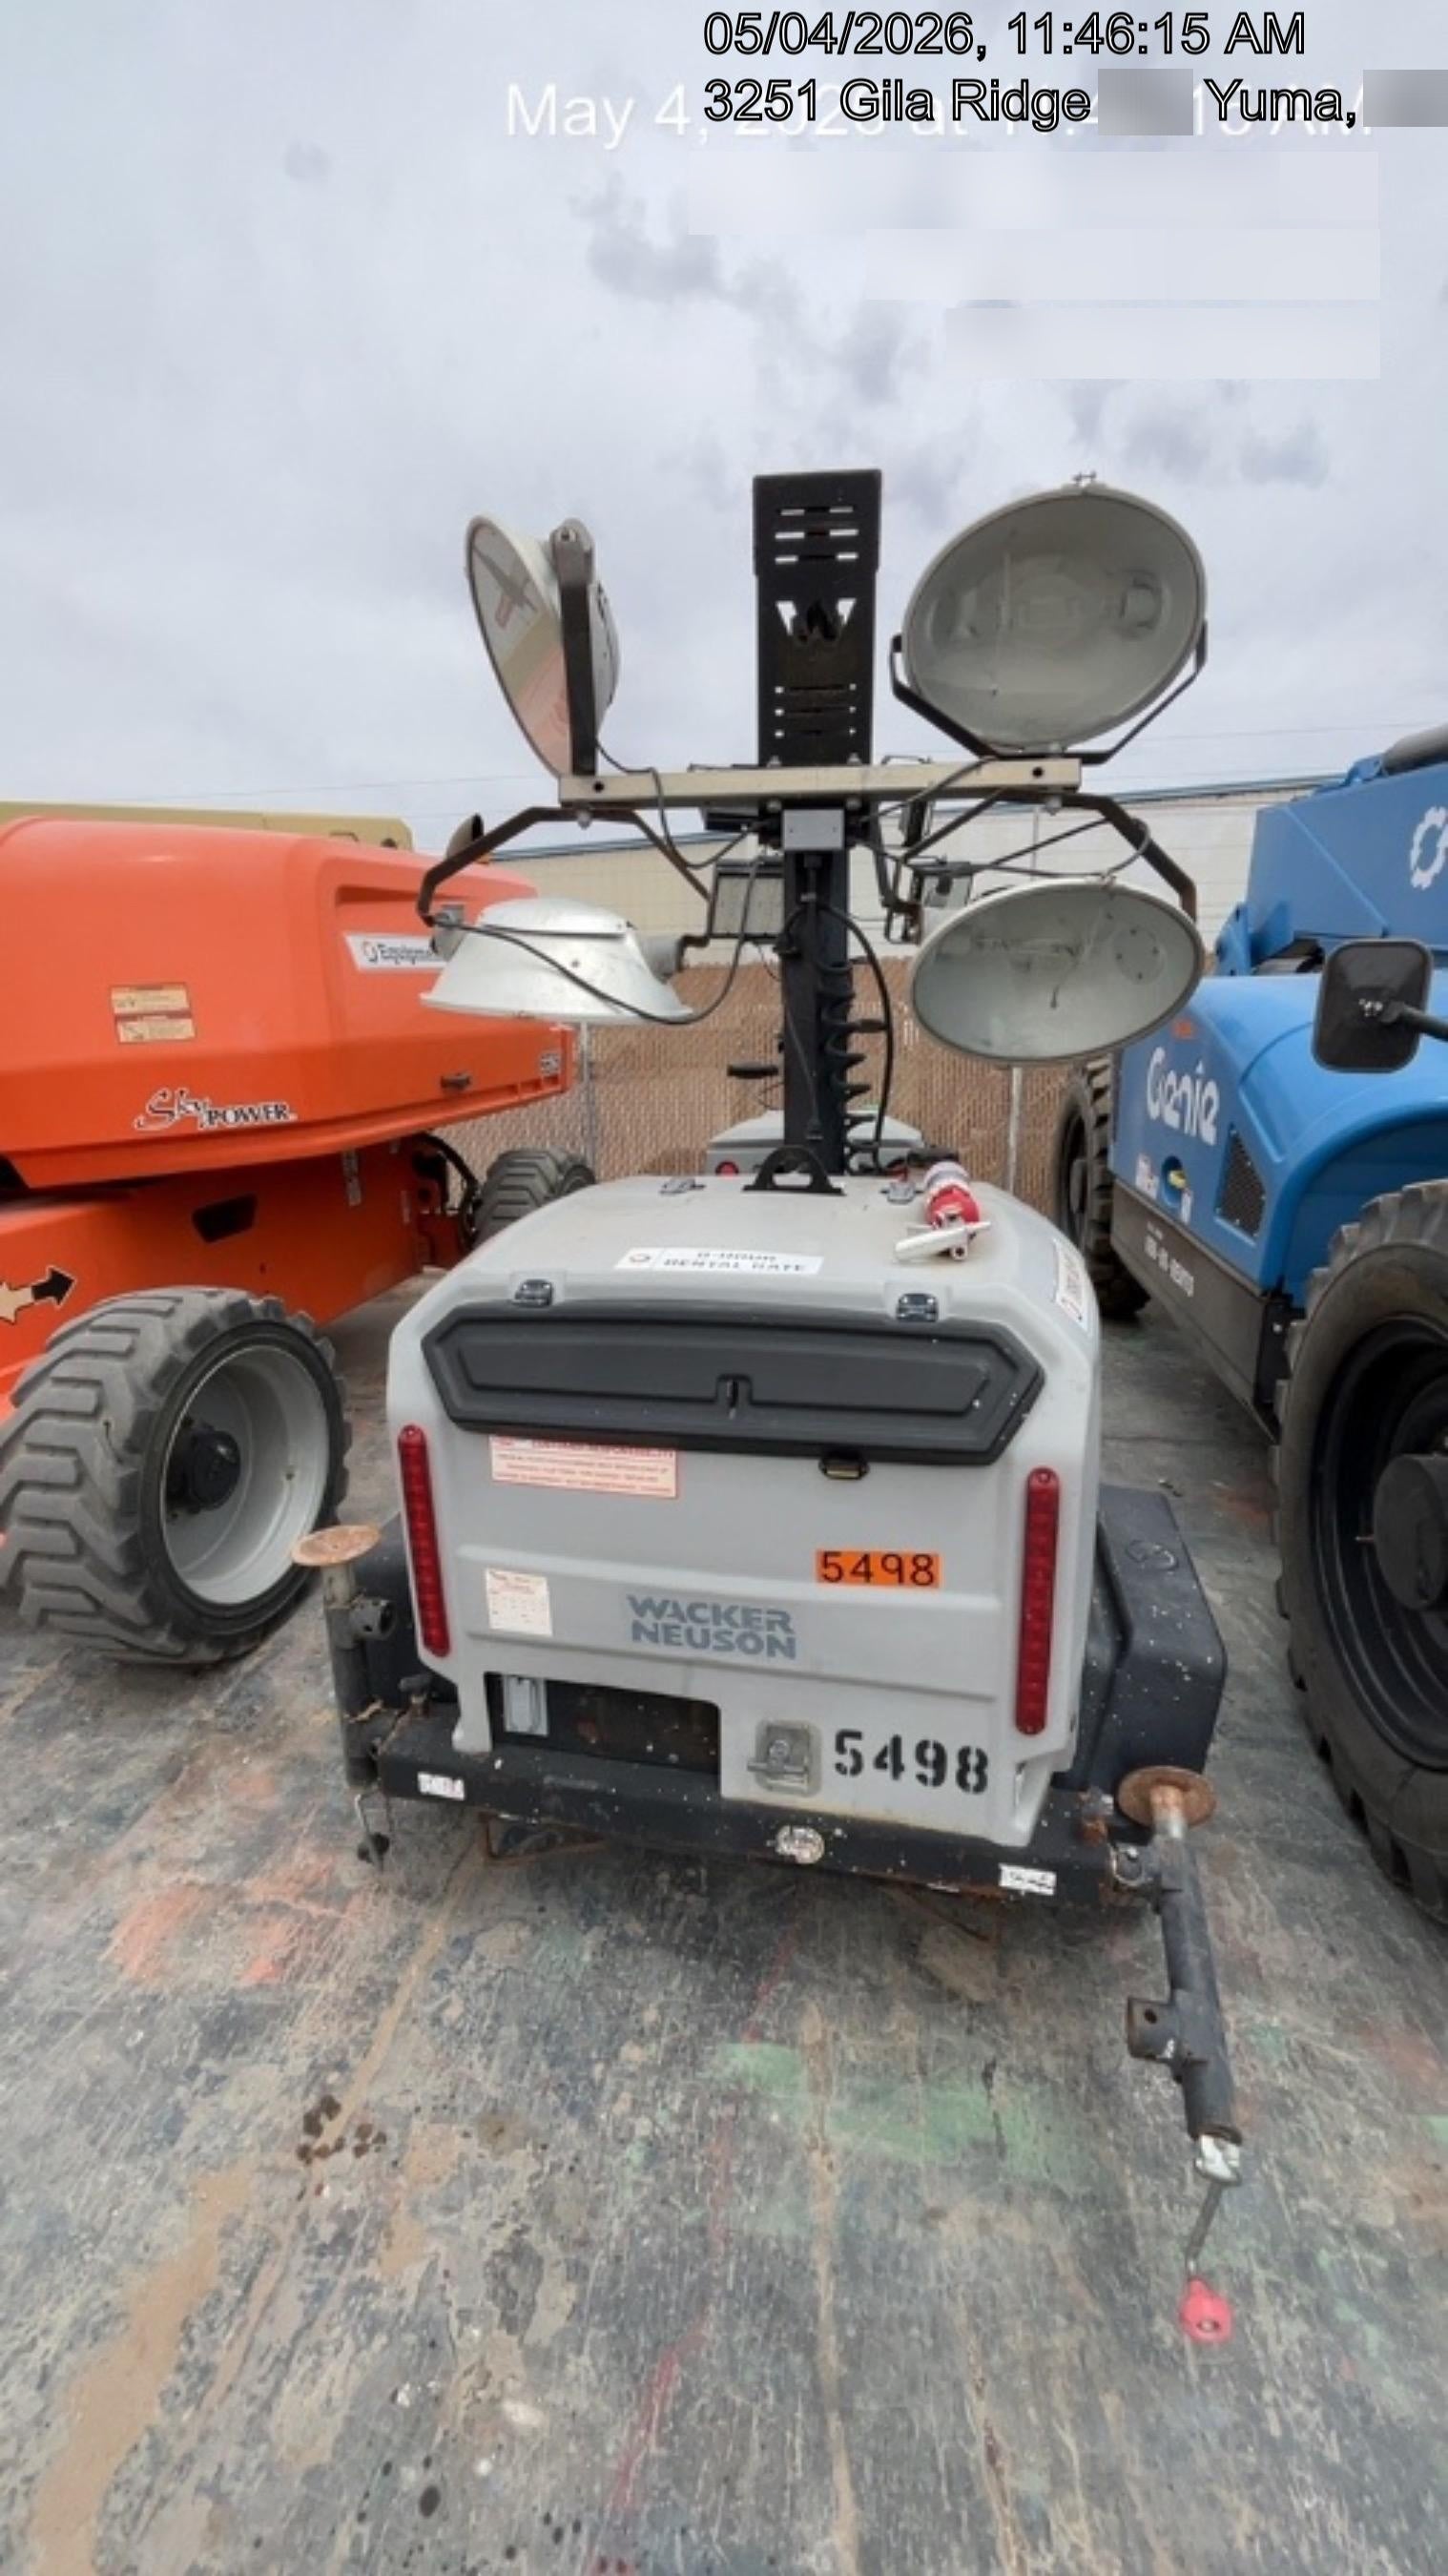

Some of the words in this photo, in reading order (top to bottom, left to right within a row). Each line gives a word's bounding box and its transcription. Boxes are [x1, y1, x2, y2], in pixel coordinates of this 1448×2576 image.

[1146, 1046, 1221, 1147] Genie
[821, 1550, 935, 1587] 5498
[627, 1594, 796, 1634] WACKER
[631, 1620, 797, 1661] NEUSON
[835, 1728, 990, 1795] 5498
